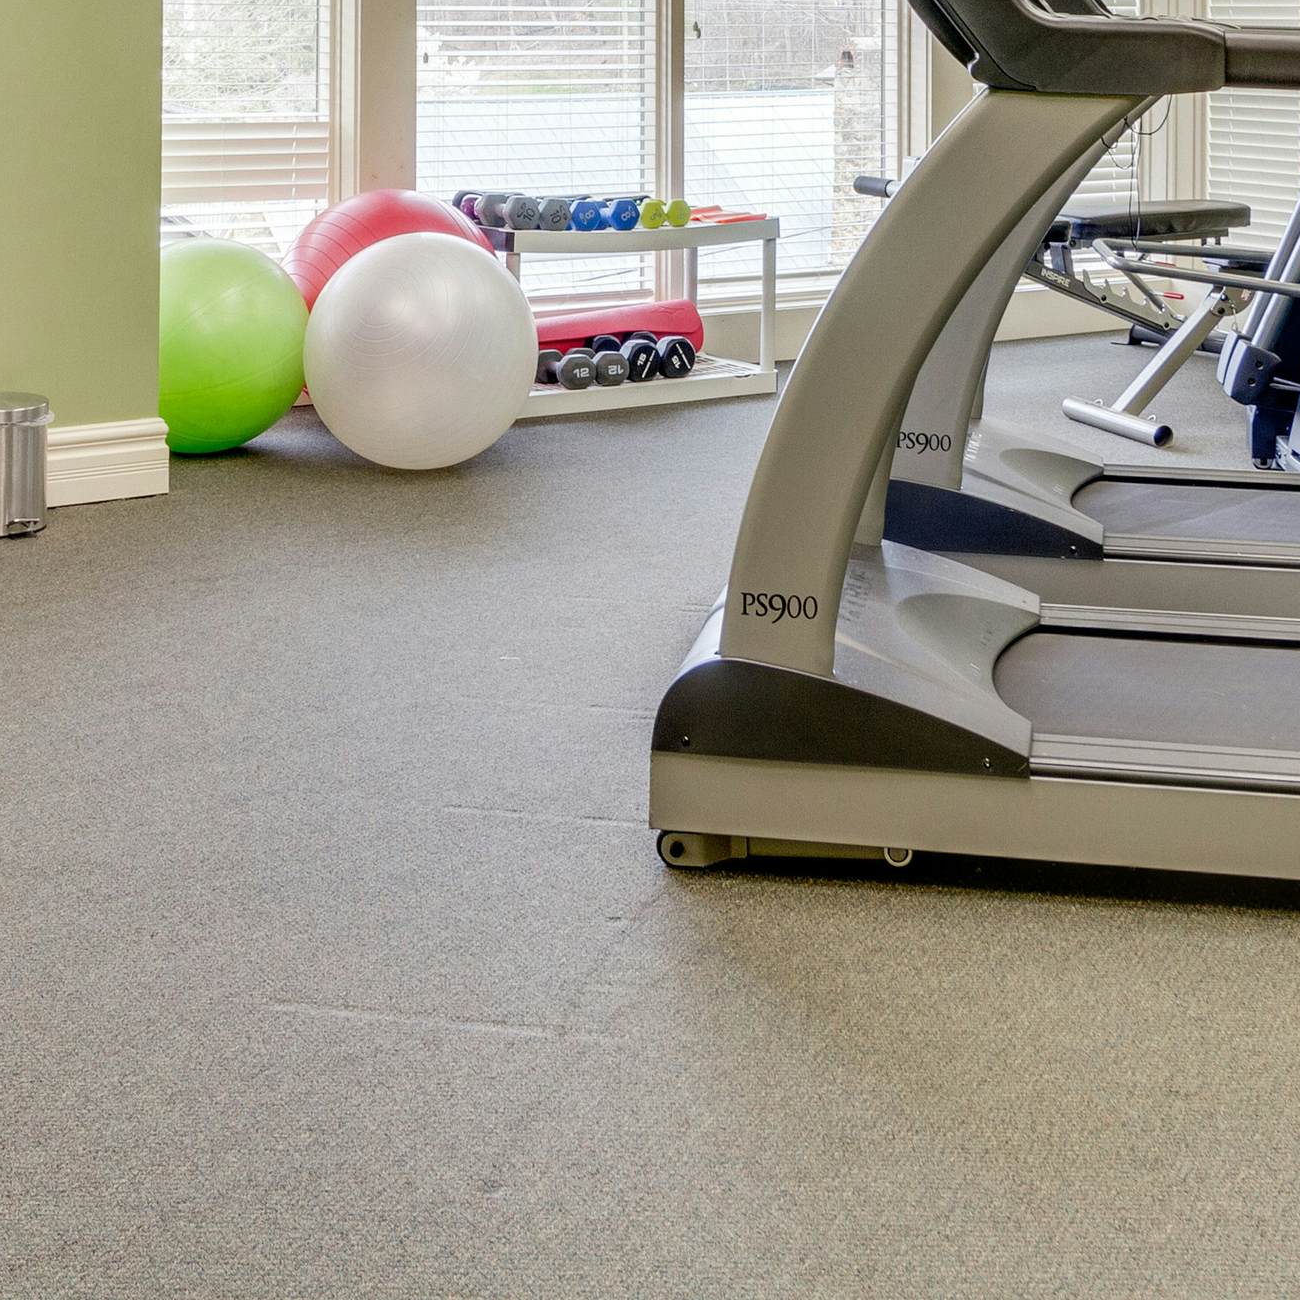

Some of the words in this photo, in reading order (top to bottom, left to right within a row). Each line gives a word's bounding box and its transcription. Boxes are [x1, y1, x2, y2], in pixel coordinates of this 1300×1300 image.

[523, 207, 536, 221] 10
[585, 209, 595, 219] 8
[620, 211, 631, 221] 8
[573, 367, 590, 379] 12
[896, 431, 952, 455] PS900
[740, 592, 818, 624] PS900
